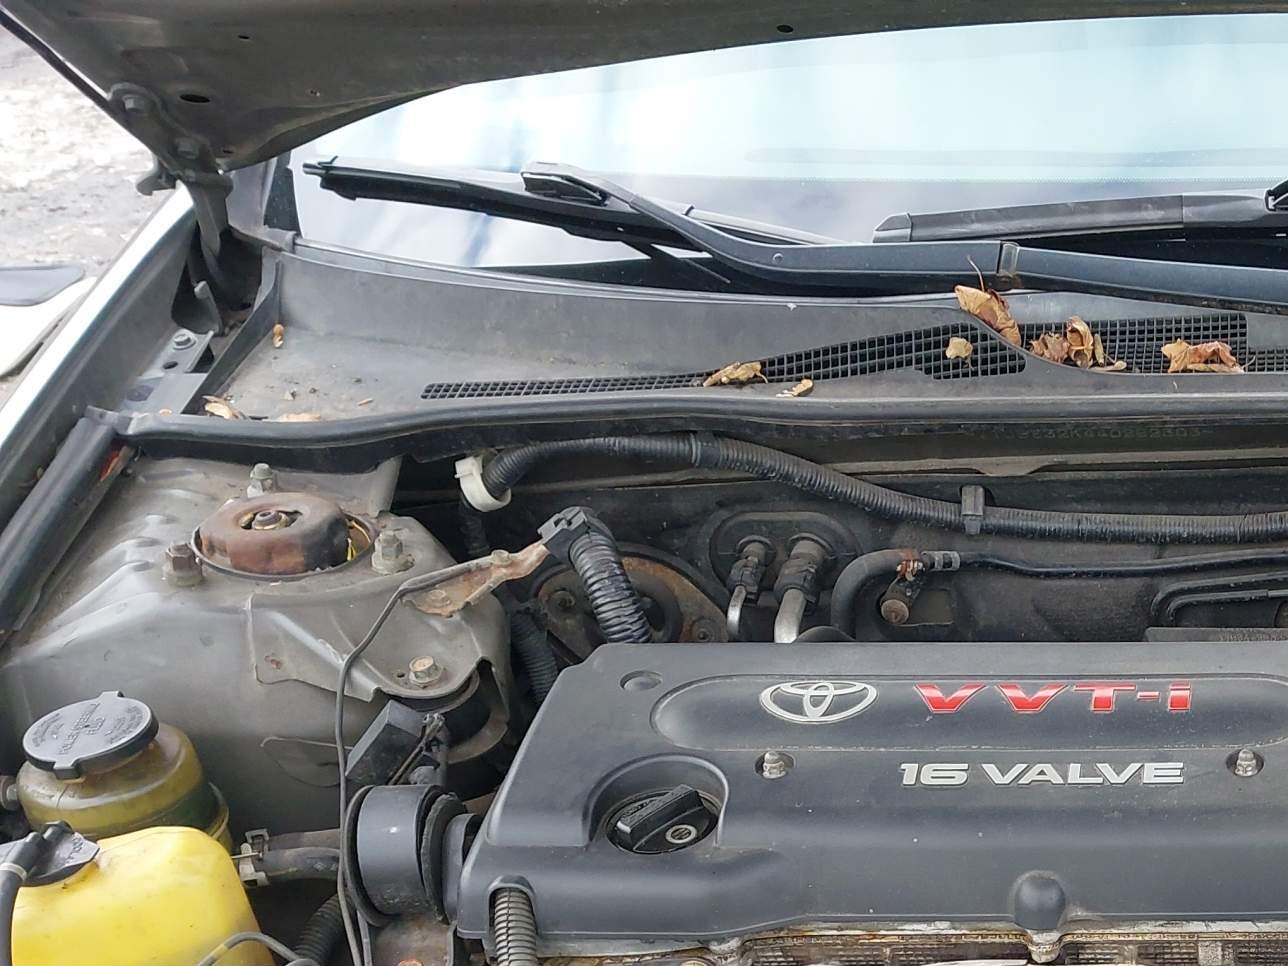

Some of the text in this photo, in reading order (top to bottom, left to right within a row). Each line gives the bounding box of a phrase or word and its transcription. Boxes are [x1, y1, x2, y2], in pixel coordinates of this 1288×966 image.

[913, 680, 1192, 714] VVT-i
[900, 762, 1185, 786] 16 VALVE
